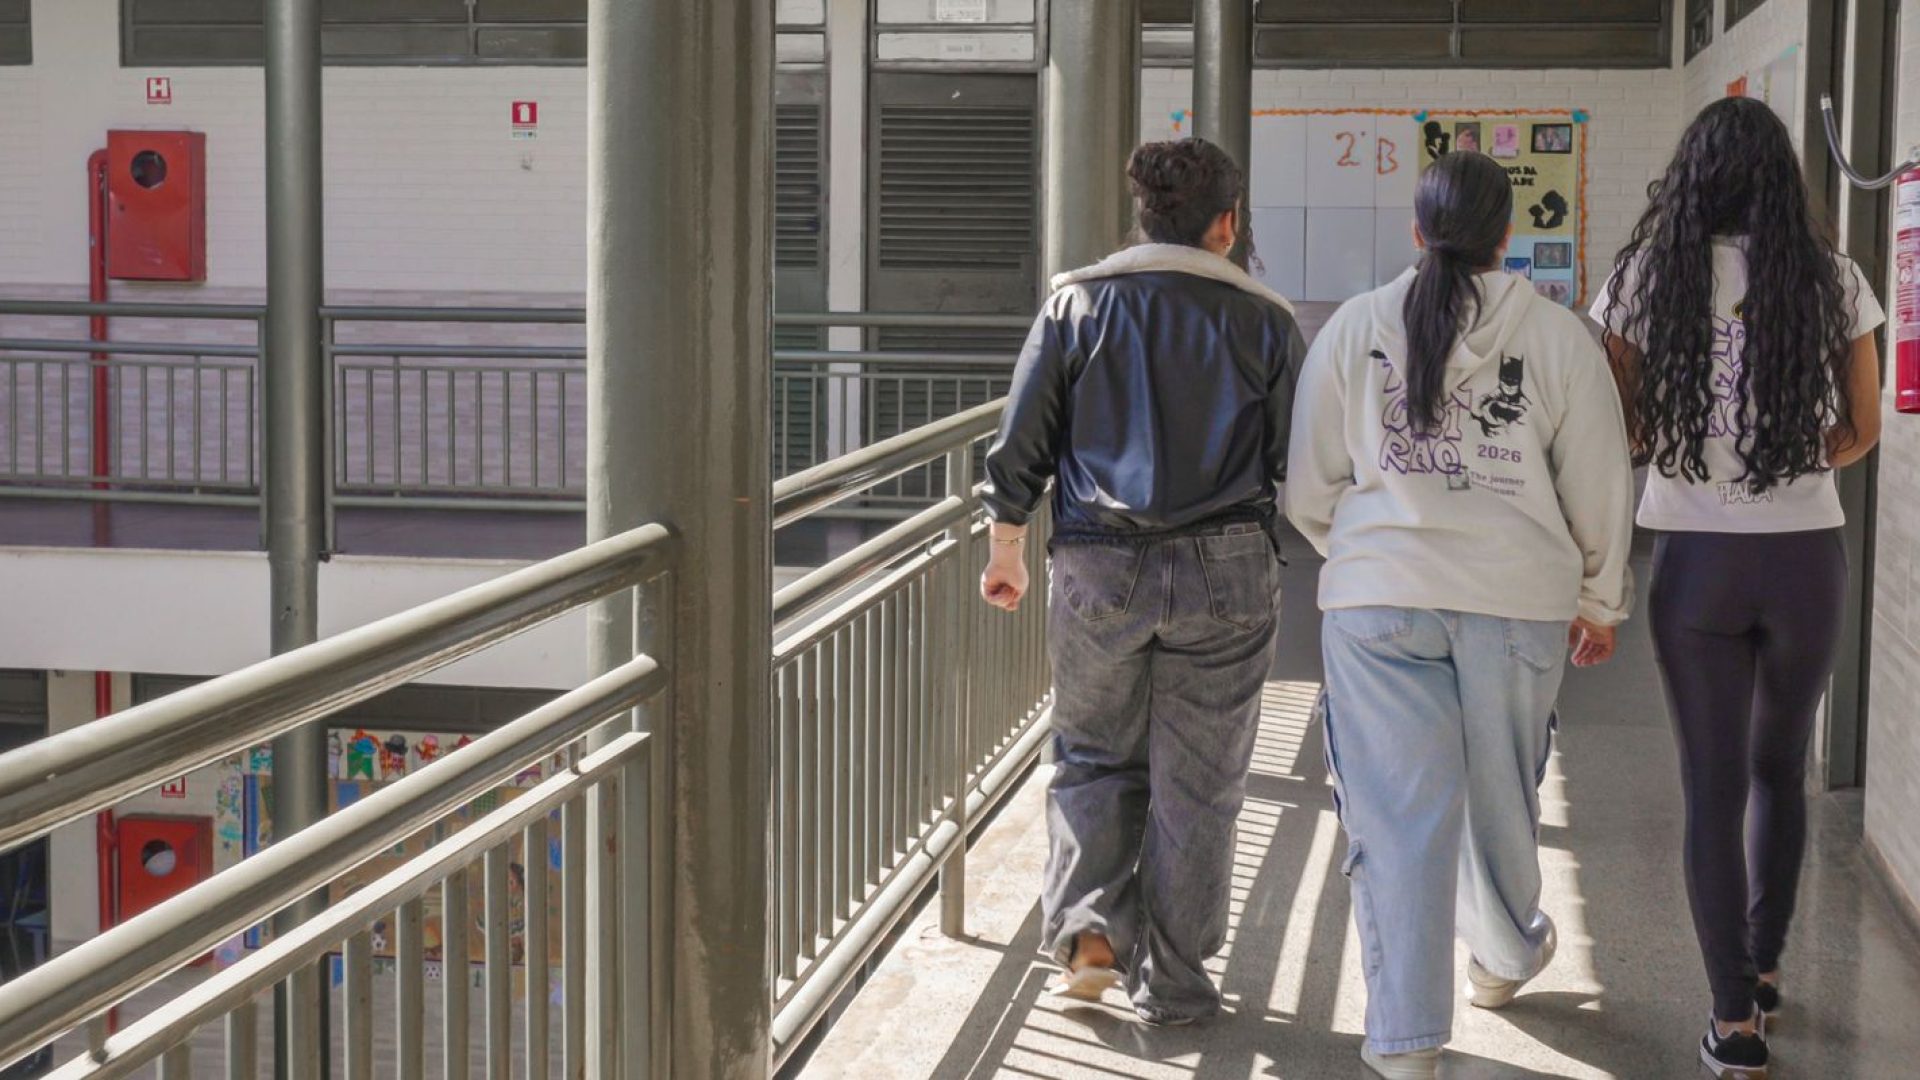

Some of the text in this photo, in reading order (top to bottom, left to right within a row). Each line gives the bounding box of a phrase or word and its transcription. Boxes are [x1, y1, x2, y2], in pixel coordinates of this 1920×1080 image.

[149, 79, 168, 97] H
[1377, 137, 1399, 175] B
[1477, 443, 1522, 463] 2026
[1470, 470, 1488, 480] The
